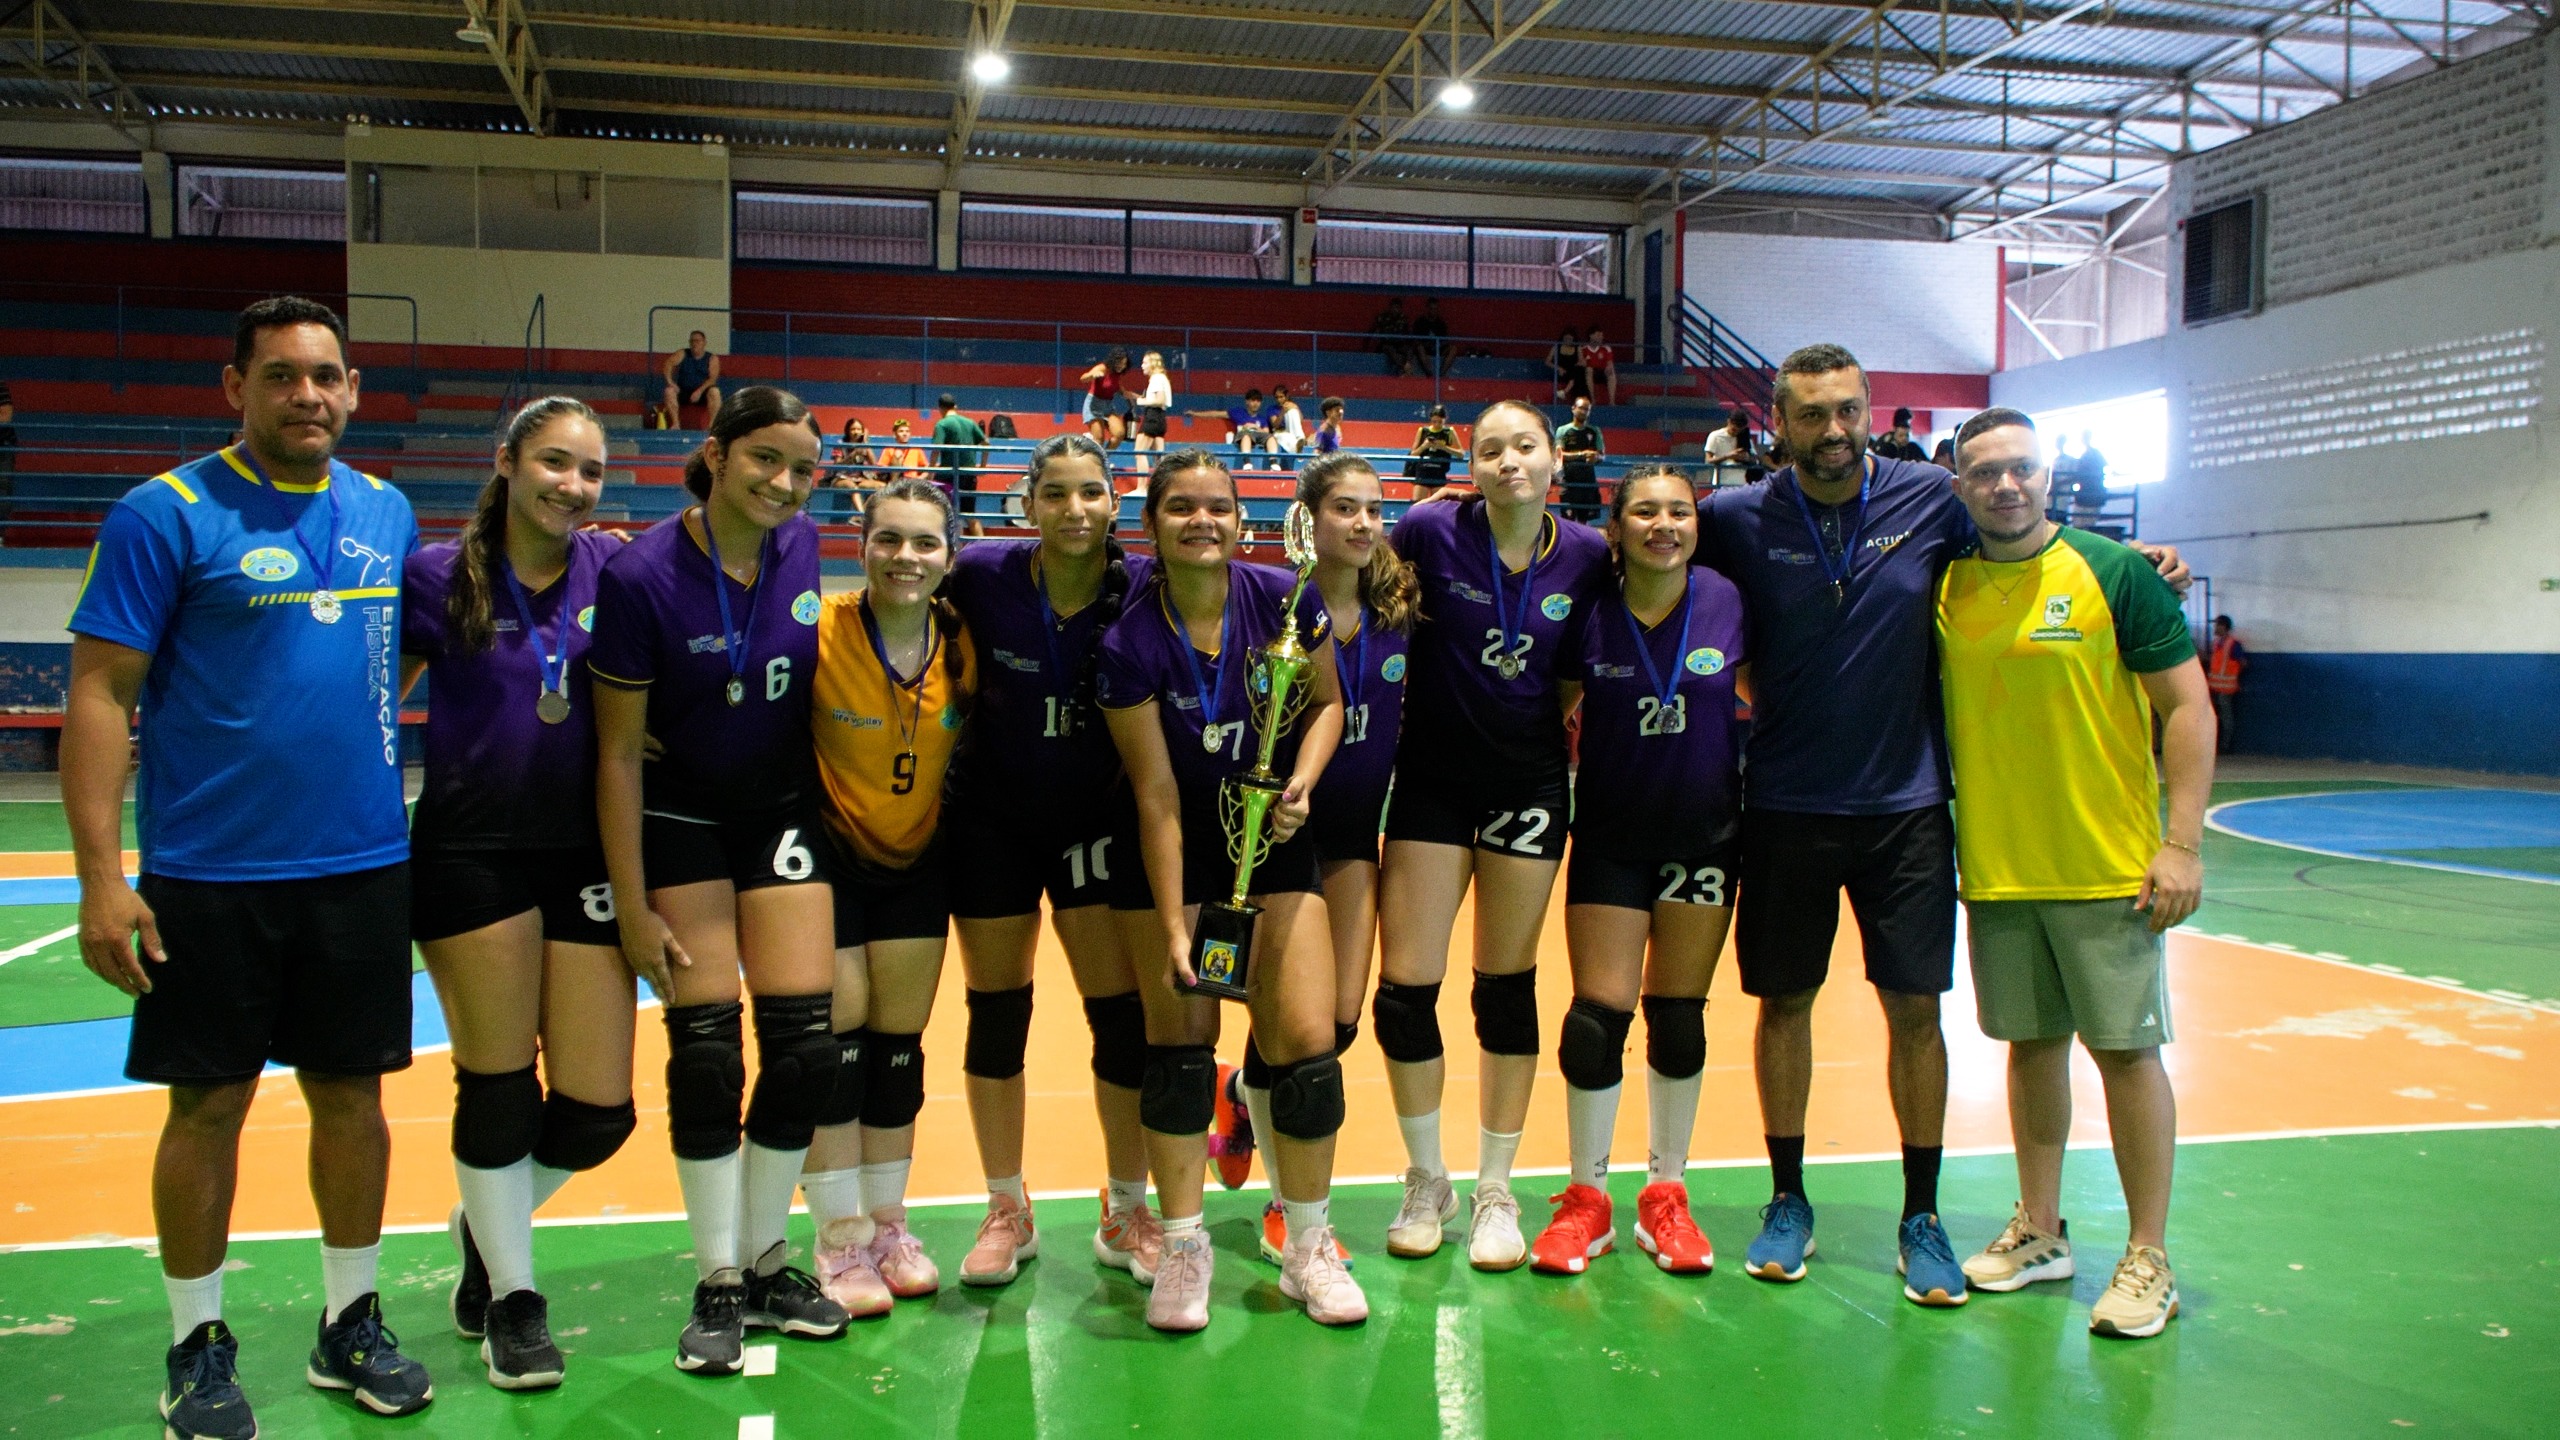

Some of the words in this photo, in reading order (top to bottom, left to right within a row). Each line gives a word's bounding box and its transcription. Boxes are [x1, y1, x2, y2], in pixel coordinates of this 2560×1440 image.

[1481, 628, 1534, 672] 22
[378, 606, 395, 767] EDUCAÇÃO
[766, 655, 791, 701] 6
[1219, 720, 1245, 761] 7
[891, 752, 918, 796] 9
[1480, 808, 1550, 855] 22
[772, 829, 813, 880] 6
[579, 882, 616, 922] 8
[1658, 862, 1725, 906] 23
